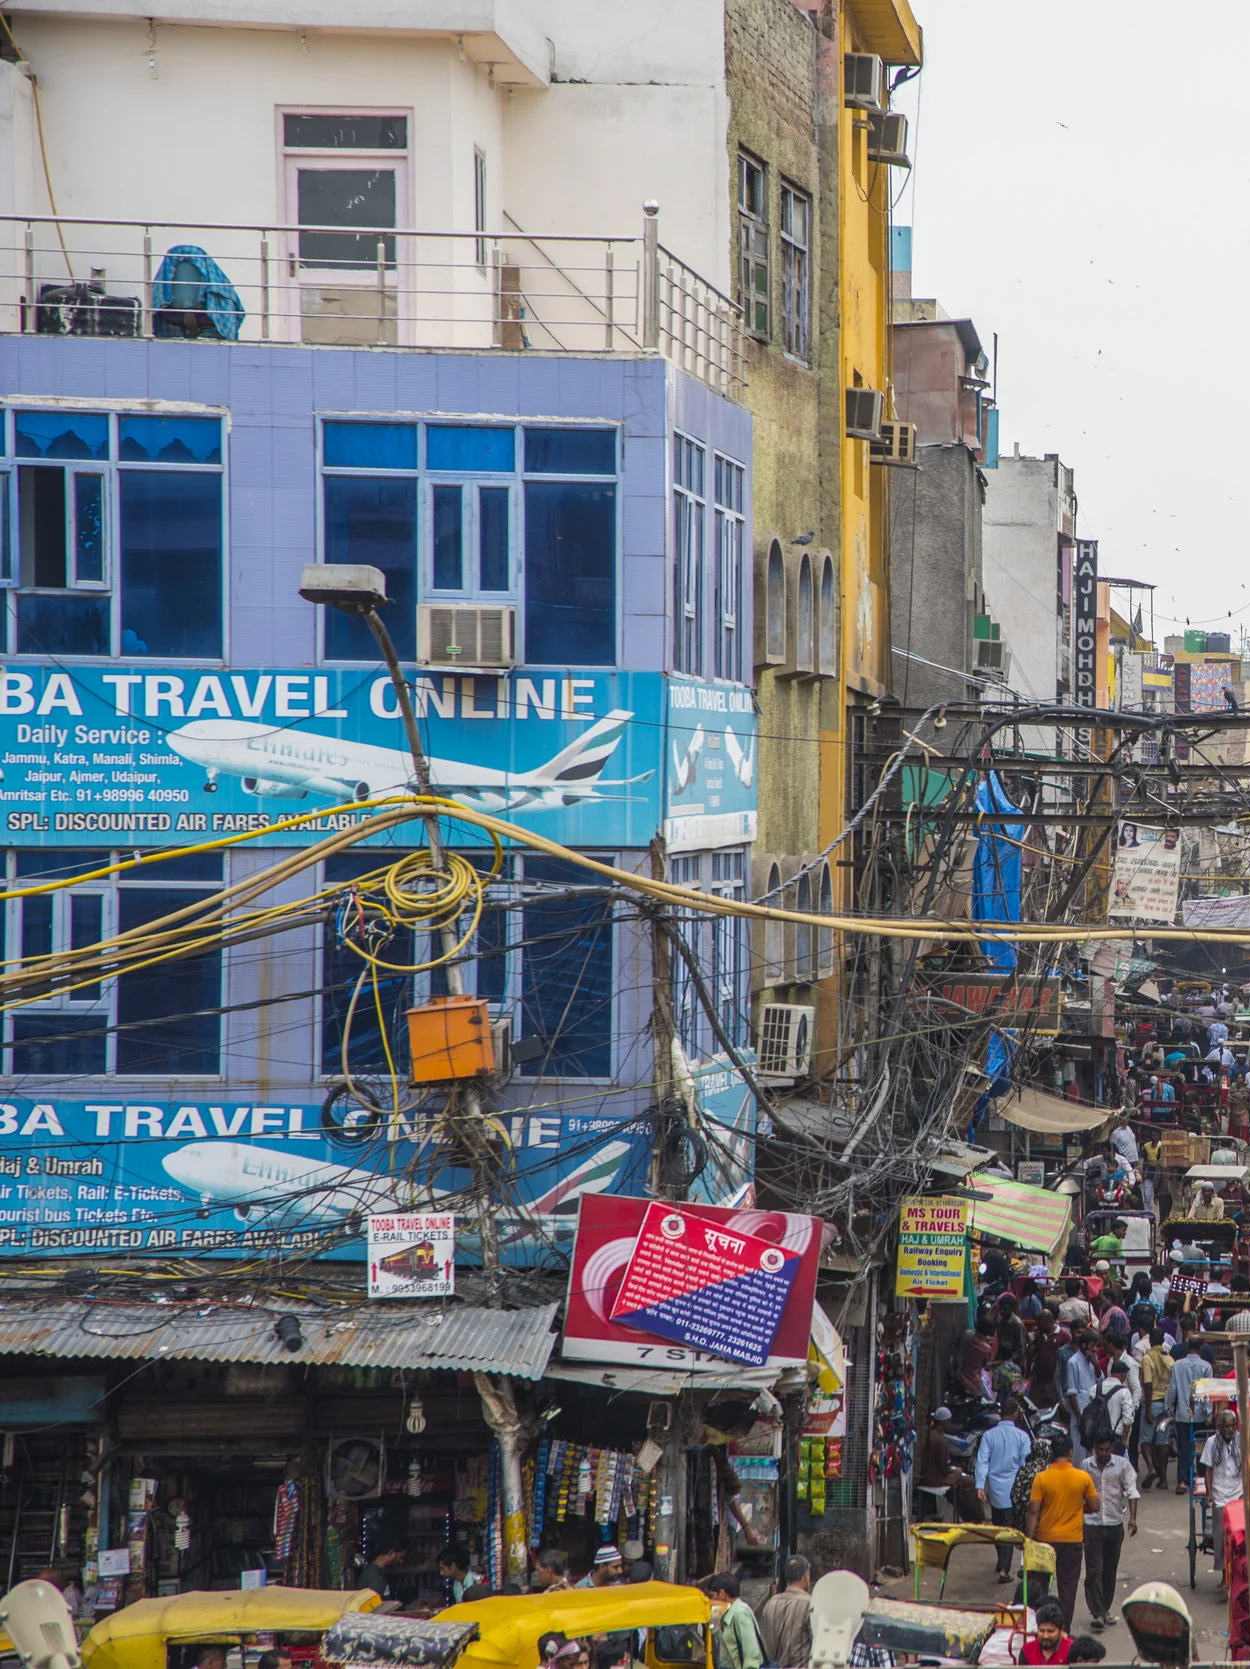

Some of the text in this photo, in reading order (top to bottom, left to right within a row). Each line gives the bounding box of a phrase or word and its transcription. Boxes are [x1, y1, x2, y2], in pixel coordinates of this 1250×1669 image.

[1078, 543, 1095, 612] HAJI
[1077, 618, 1095, 687] MOHD
[103, 674, 348, 718] TRAVEL
[369, 676, 596, 721] ONLINE
[669, 685, 696, 709] TOOBA
[697, 687, 728, 712] TRAVEL
[17, 724, 68, 747] Daily
[75, 724, 150, 744] Service
[1, 752, 184, 767] Jammu, Katra, Manali, Shimla,
[24, 770, 161, 784] Jaipur, Ajmer, Udaipur,
[51, 789, 72, 802] Etc.
[76, 789, 144, 802] 91+98996
[147, 790, 190, 802] 40950
[7, 812, 49, 831] SPL:
[54, 812, 171, 831] DISCOUNTED
[175, 812, 207, 831] AIR
[212, 813, 270, 831] FARES
[85, 1105, 321, 1139] TRAVEL
[26, 1156, 41, 1175] &
[45, 1156, 104, 1176] Umrah
[16, 1185, 72, 1202] Tickets,
[77, 1185, 109, 1200] Rail:
[113, 1186, 185, 1203] E-Tickets,
[45, 1208, 71, 1222] bus
[75, 1208, 127, 1223] Tickets
[907, 1207, 960, 1220] MS TOUR
[371, 1217, 451, 1231] TOOBA TRAVEL ONLINE
[901, 1220, 965, 1232] & TRAVELS
[31, 1229, 143, 1247] DISCOUNTED
[146, 1230, 176, 1247] AIR
[181, 1230, 237, 1248] FARES
[373, 1230, 449, 1242] E-RAIL TICKETS
[704, 1227, 746, 1255] सूचना
[901, 1234, 964, 1245] HAJ & UMRAH
[903, 1246, 963, 1257] Railway Enquiry
[917, 1258, 948, 1268] Booking
[900, 1268, 923, 1276] Domestic
[929, 1269, 962, 1278] International
[636, 1346, 652, 1358] 7
[683, 1331, 763, 1365] S.H.O. JAMA MASJID
